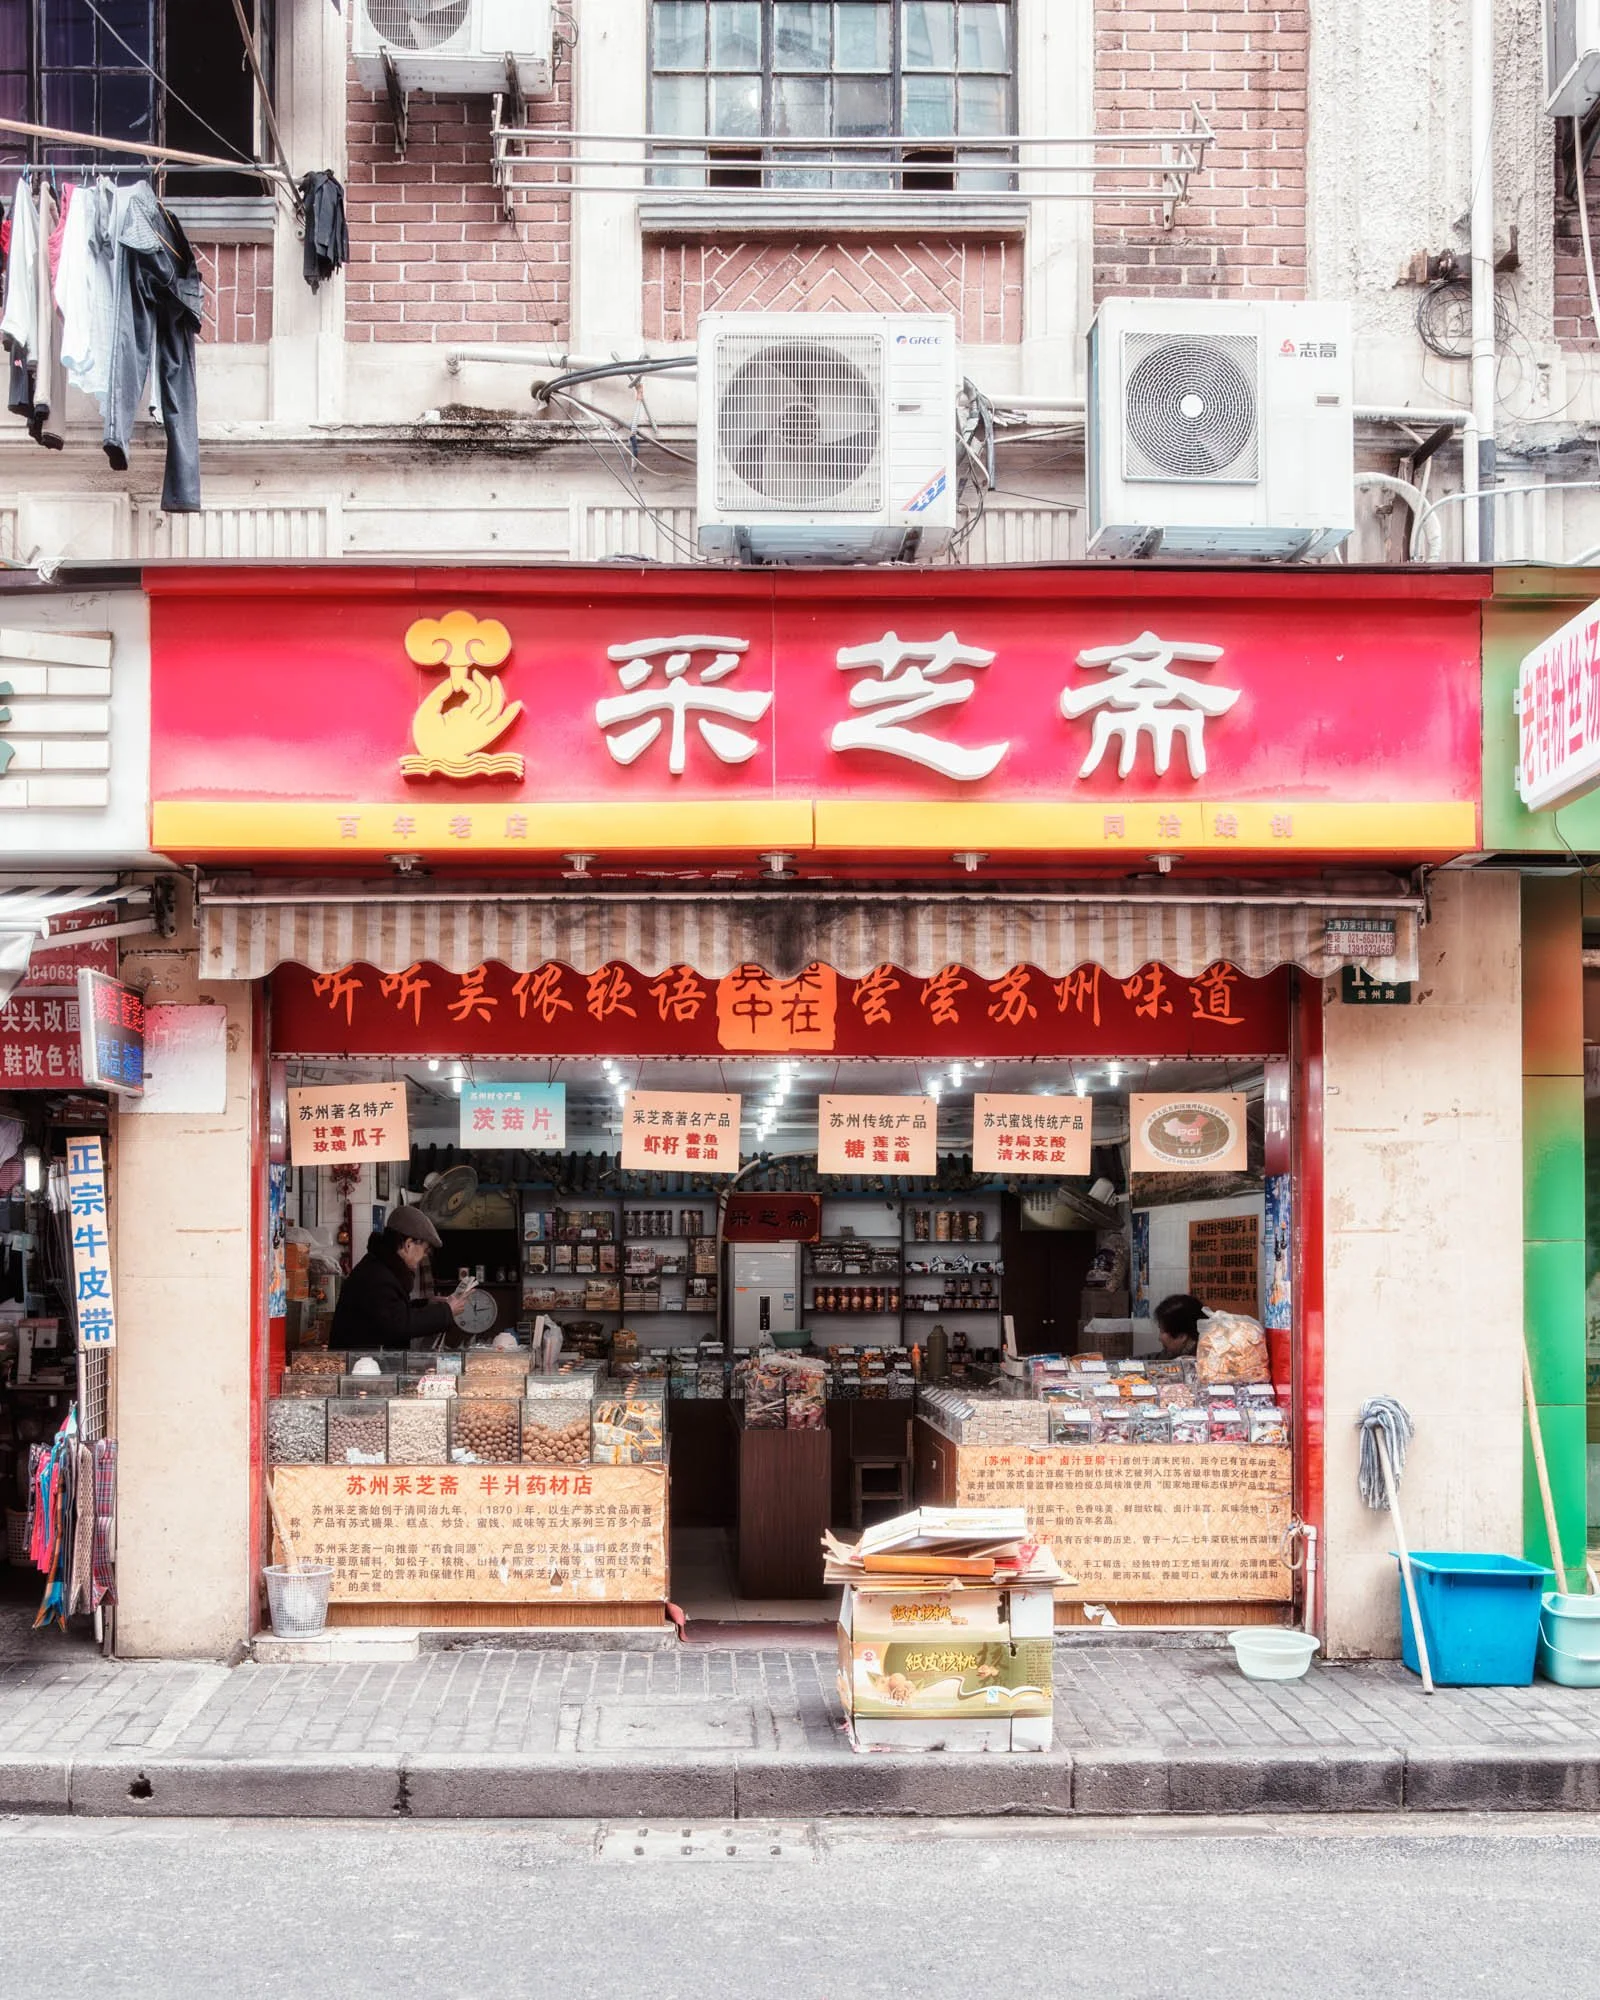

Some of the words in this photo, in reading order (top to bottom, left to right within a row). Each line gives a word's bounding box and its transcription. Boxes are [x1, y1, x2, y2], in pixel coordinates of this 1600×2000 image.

[909, 336, 944, 345] GREE
[1299, 342, 1336, 358] 志高
[595, 631, 1243, 780] 采芝斋
[1523, 621, 1600, 785] 老鸭粉丝汤
[337, 813, 529, 839] 百年老店
[1103, 813, 1294, 839] 同治始创
[312, 962, 707, 1027] 听听吴侬软语
[852, 963, 1246, 1027] 尝尝苏州味道
[1357, 989, 1395, 1000] 贵州路
[299, 1101, 393, 1120] 苏州著名特产
[473, 1107, 553, 1131] 茨菇片
[633, 1109, 730, 1128] 采芝斋著名产品
[830, 1113, 926, 1129] 苏州传统产品
[983, 1113, 1084, 1130] 苏式蜜饯传统产品
[313, 1126, 347, 1138] 甘草
[351, 1128, 386, 1147] 瓜子
[1178, 1128, 1199, 1136] PGI
[313, 1140, 347, 1152] 玫瑰
[644, 1134, 680, 1155] 虾籽
[845, 1139, 865, 1158] 糖
[872, 1136, 910, 1148] 莲芯
[997, 1149, 1066, 1162] 清水陈皮
[69, 1144, 114, 1342] 正宗牛皮带
[346, 1475, 459, 1496] 苏州采芝斋
[479, 1475, 593, 1496] 半爿药材店
[905, 1650, 978, 1672] 紙皮核桃
